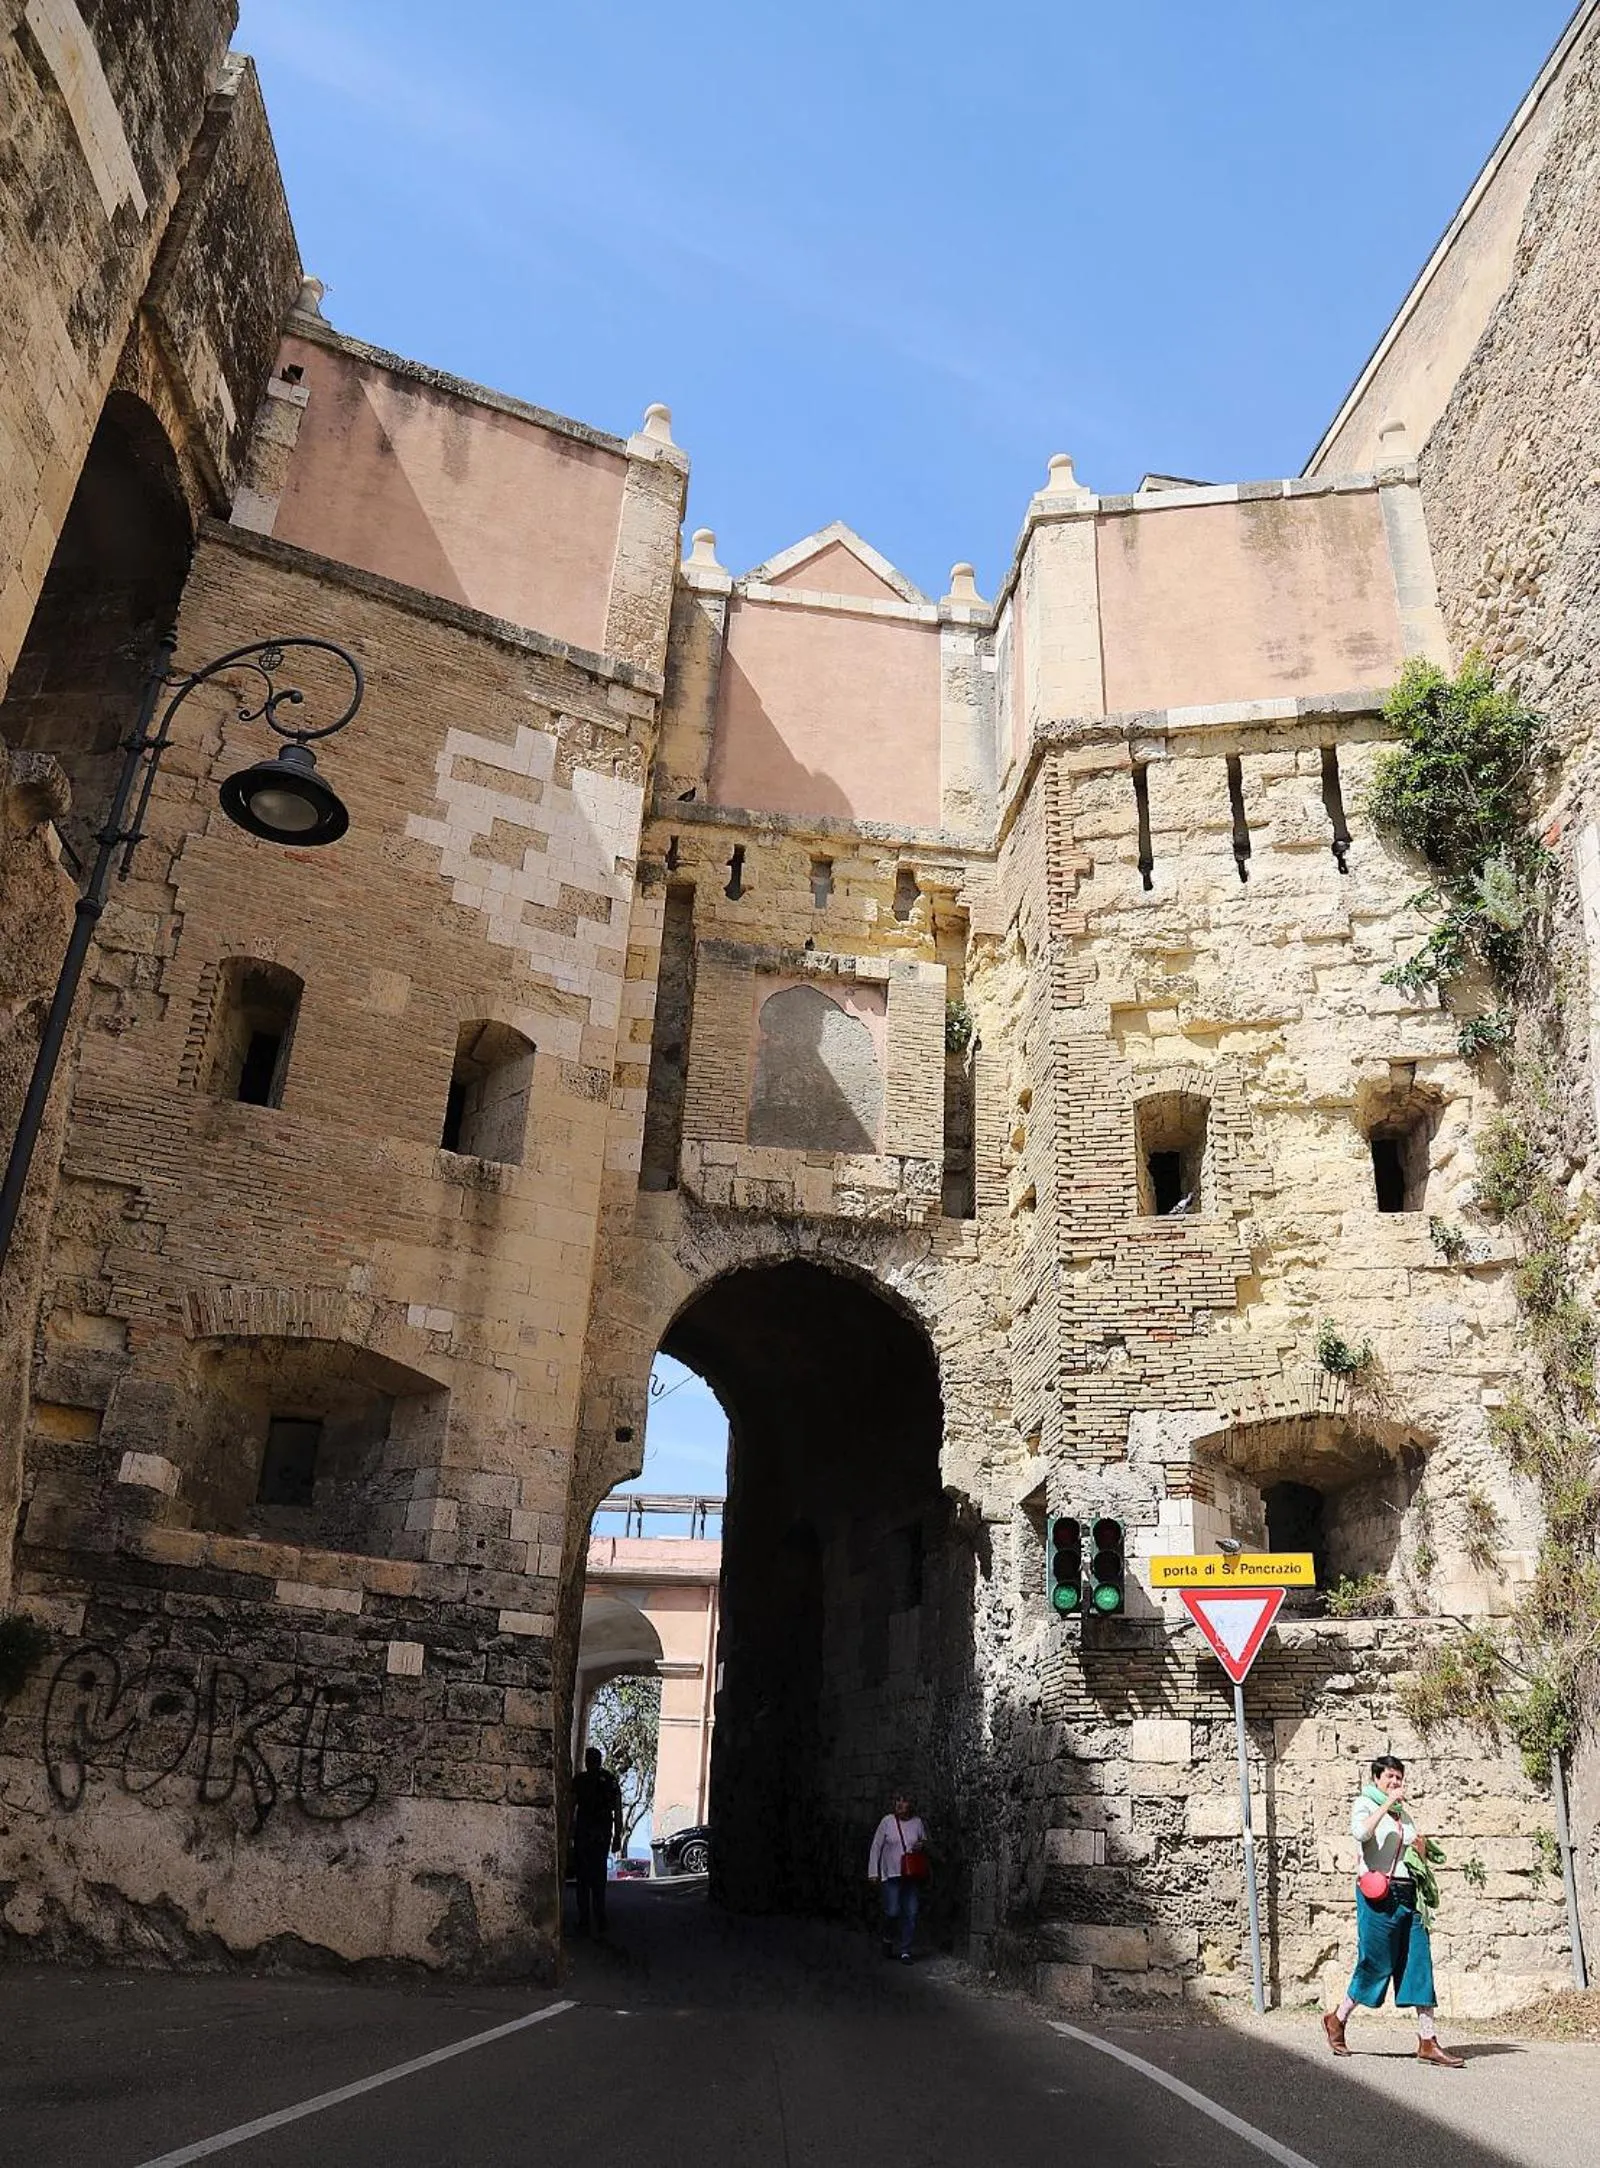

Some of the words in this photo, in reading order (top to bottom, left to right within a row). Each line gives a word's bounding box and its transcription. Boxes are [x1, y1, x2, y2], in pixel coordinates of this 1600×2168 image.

[1163, 1564, 1198, 1577] porta
[1204, 1564, 1215, 1575] di
[1221, 1563, 1235, 1575] S.
[1240, 1562, 1302, 1575] Pancrazio
